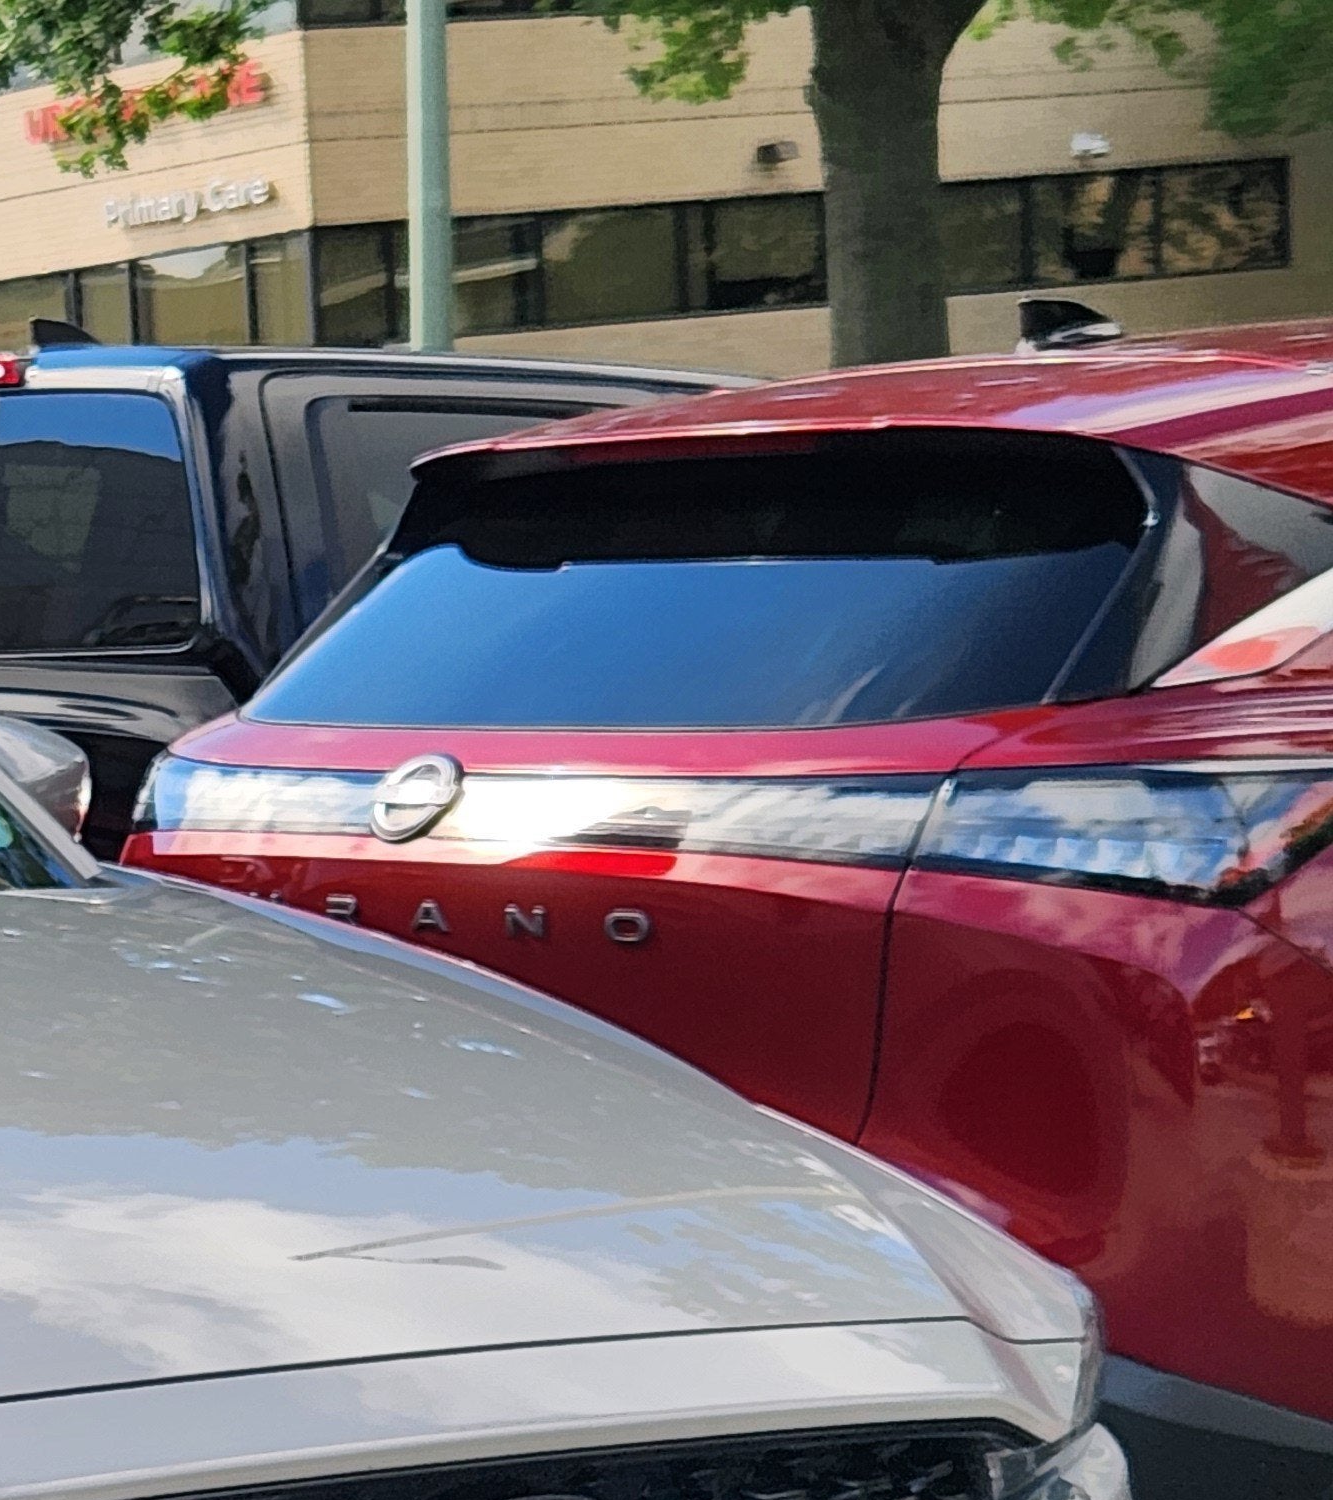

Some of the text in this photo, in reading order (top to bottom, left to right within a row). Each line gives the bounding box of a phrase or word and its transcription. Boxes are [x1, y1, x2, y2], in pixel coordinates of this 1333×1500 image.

[104, 178, 270, 228] Primary Care
[247, 890, 653, 944] RANO
